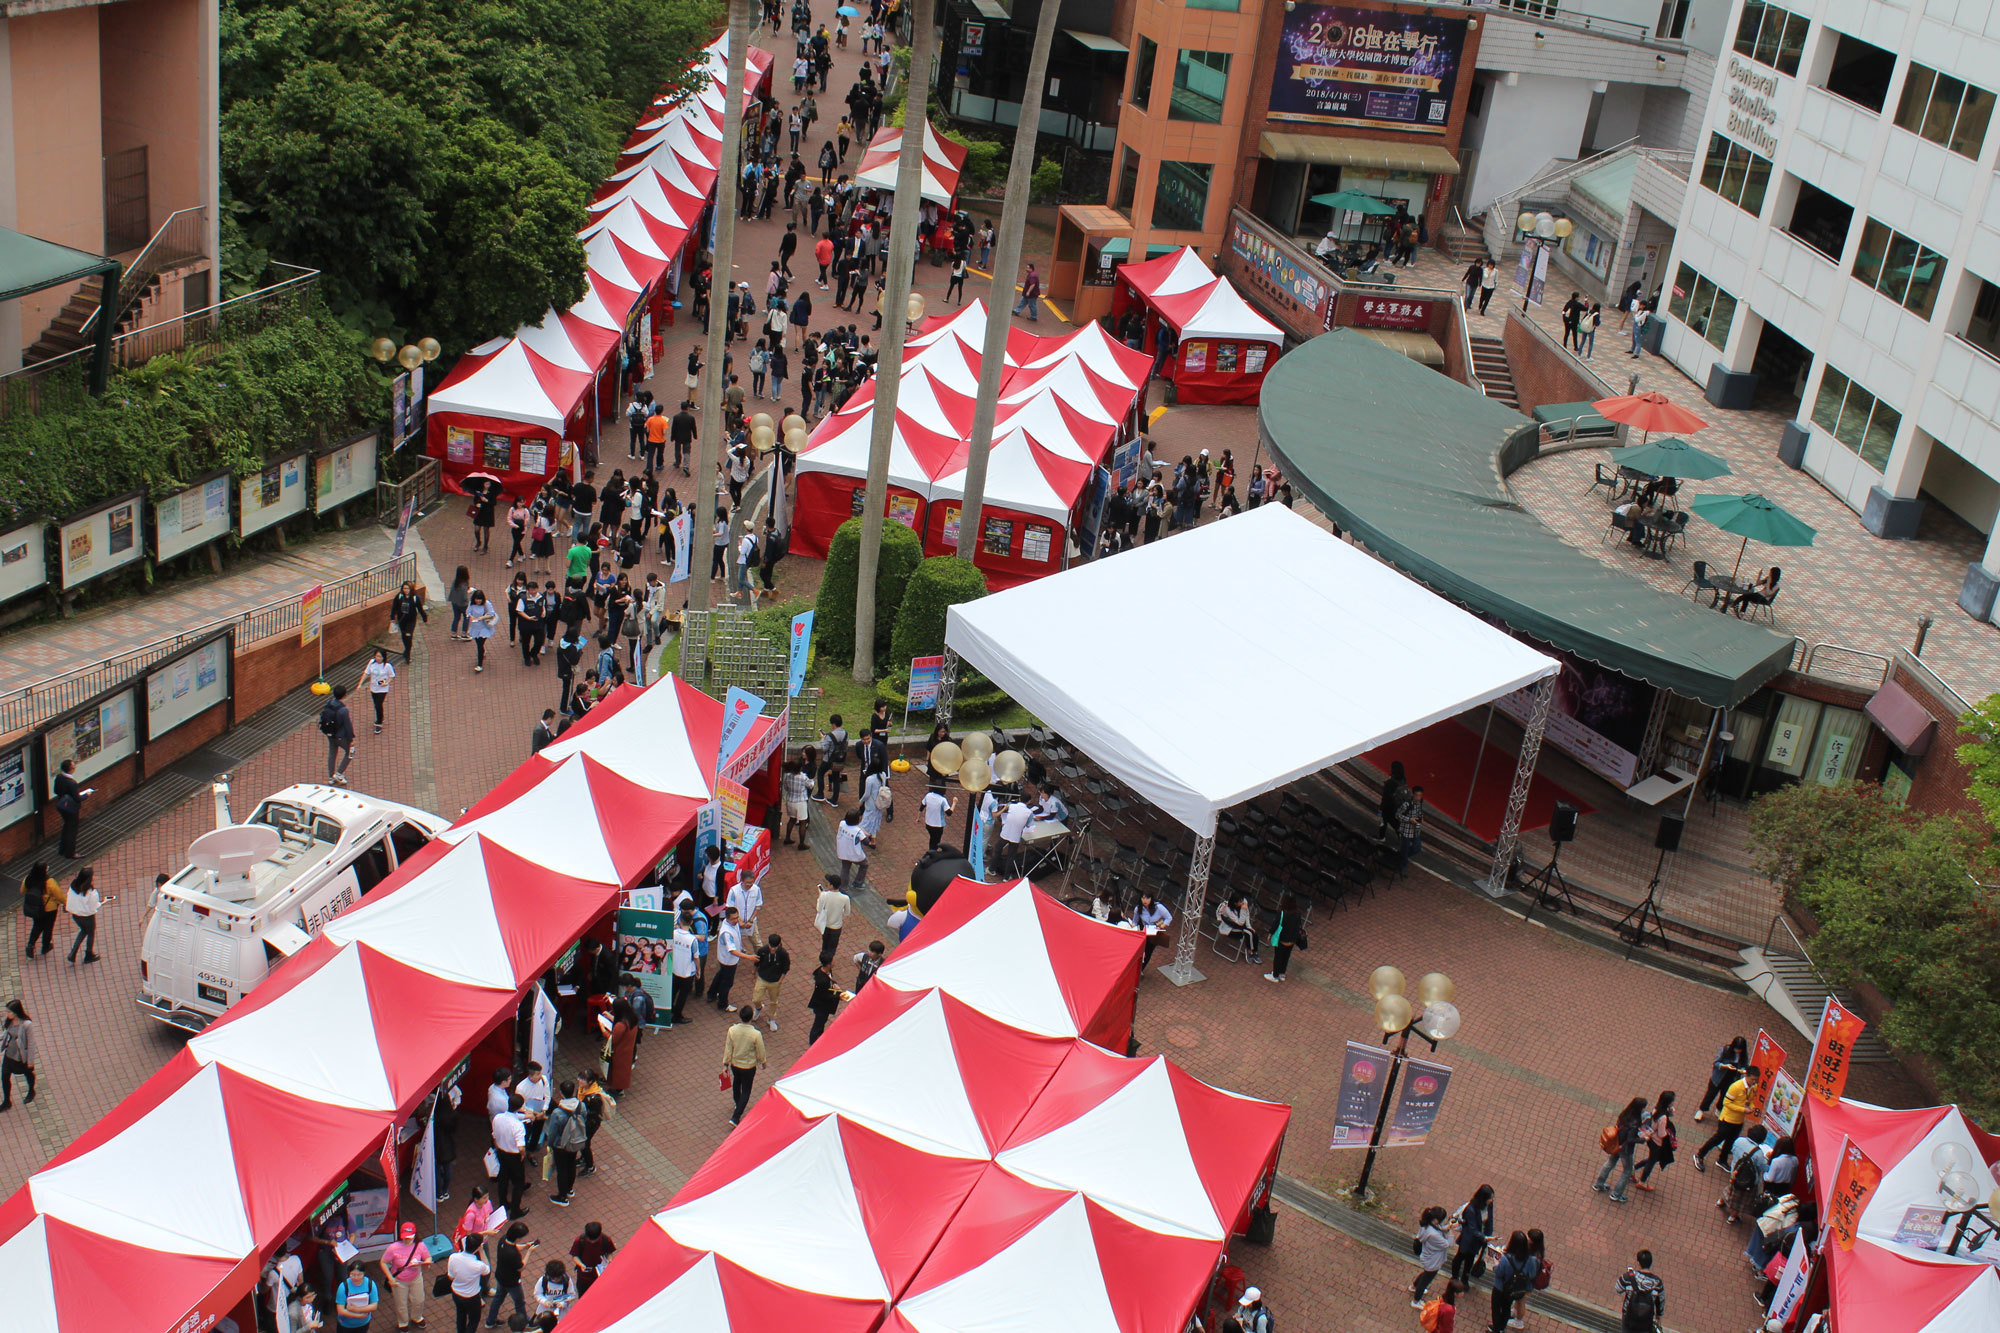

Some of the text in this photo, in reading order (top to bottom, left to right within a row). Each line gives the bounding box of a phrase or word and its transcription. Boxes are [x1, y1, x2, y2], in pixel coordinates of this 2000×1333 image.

[1728, 57, 1778, 98] General
[1728, 85, 1777, 125] Studies
[1727, 109, 1778, 159] Building
[1363, 301, 1424, 318] 學生事務處
[308, 886, 354, 934] 非凡新聞
[198, 971, 233, 988] 493-BJ
